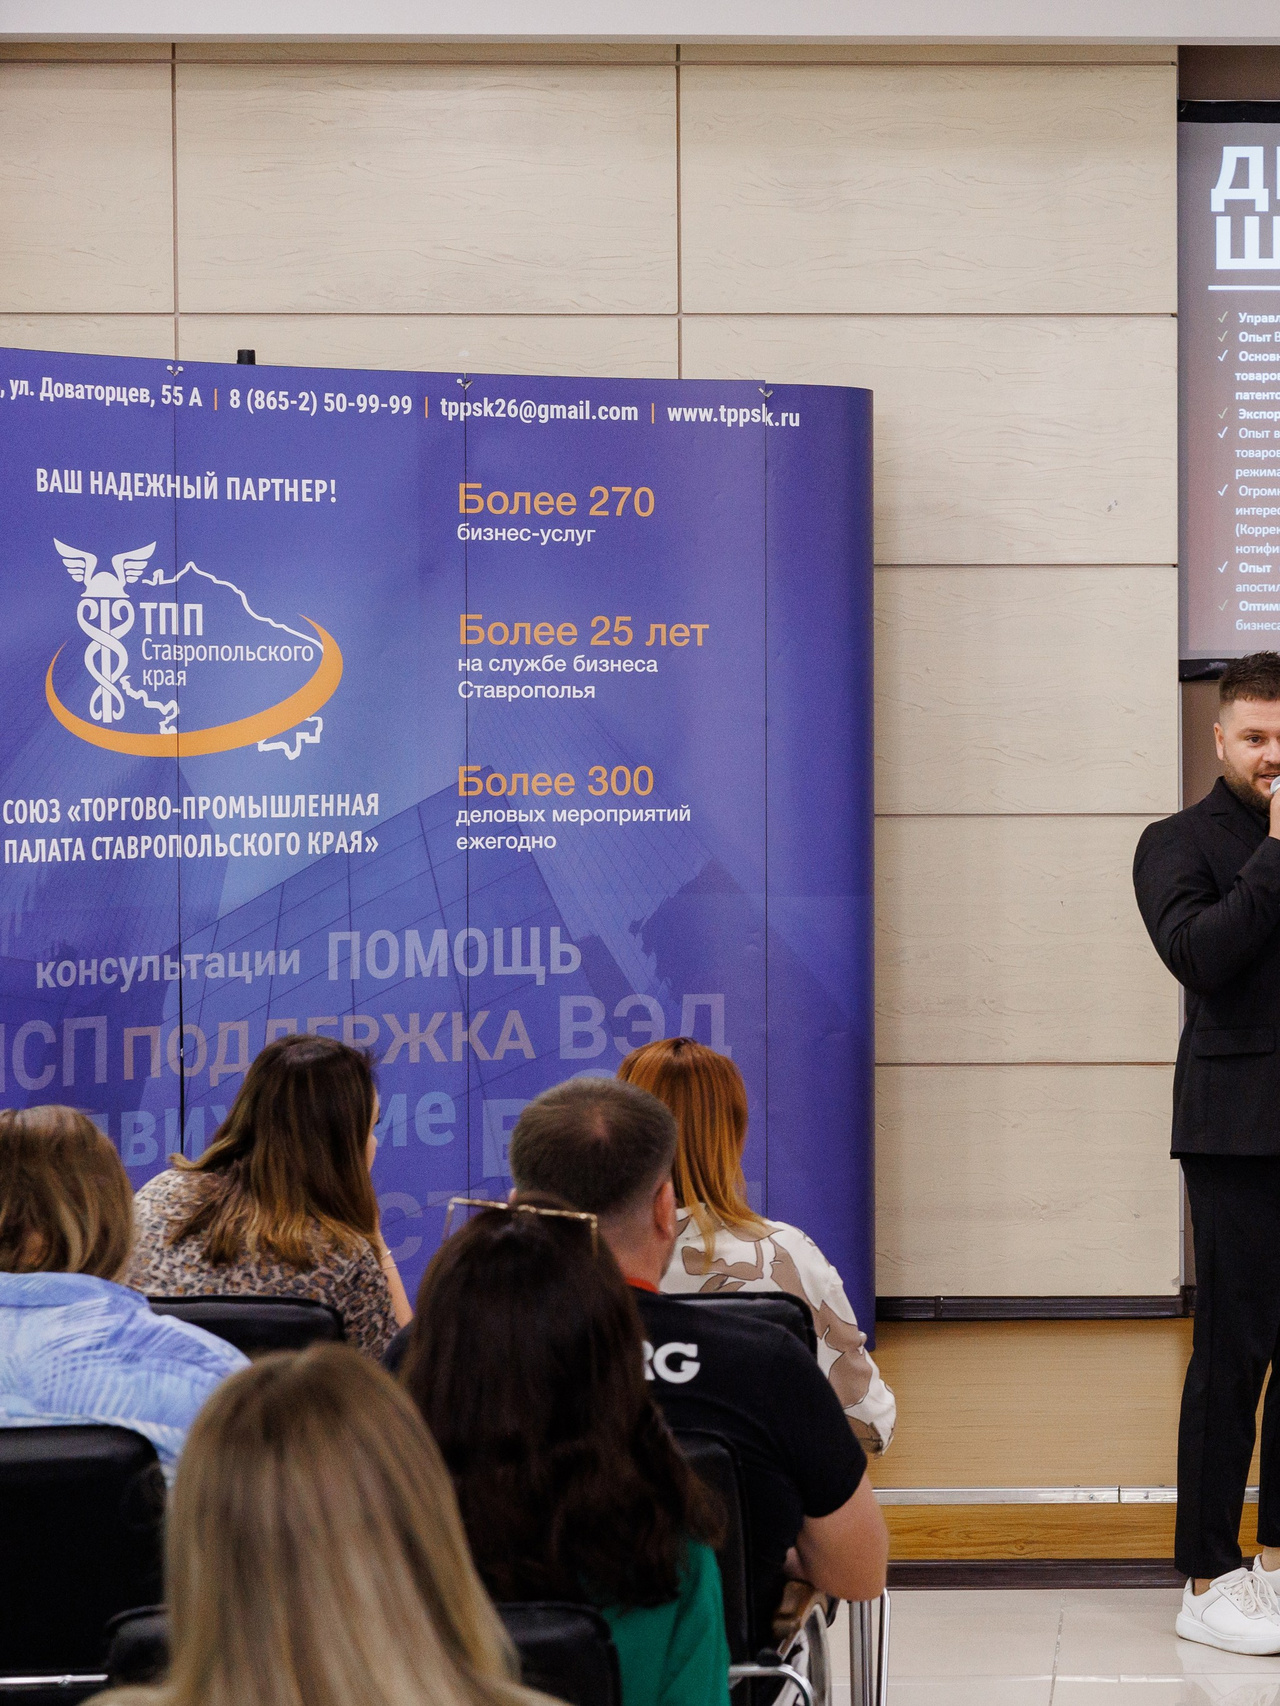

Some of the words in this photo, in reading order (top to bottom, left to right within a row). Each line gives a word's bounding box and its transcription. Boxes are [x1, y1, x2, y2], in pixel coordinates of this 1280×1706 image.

[1238, 331, 1272, 343] Опыт
[10, 377, 34, 401] ул.
[40, 377, 155, 407] Доваторцев,
[162, 385, 183, 405] 55
[189, 386, 202, 406] А
[229, 389, 240, 408] 8
[248, 389, 317, 416] (865-2)
[324, 393, 411, 414] 50-99-99
[440, 397, 638, 423] tppsk26@gmail.com
[667, 403, 800, 428] www.tppsk.ru
[36, 469, 82, 494] ВАШ
[90, 471, 218, 501] НАДЕЖНЫЙ
[227, 478, 337, 503] ПАРТНЕР!
[458, 483, 576, 515] Более
[589, 486, 655, 517] 270
[457, 523, 596, 546] бизнес-услуг
[140, 603, 203, 635] ТПП
[459, 614, 577, 646] Более
[590, 616, 633, 646] 25
[645, 623, 709, 647] лет
[142, 638, 314, 665] Ставропольского
[458, 656, 482, 672] на
[488, 655, 566, 675] службе
[573, 655, 658, 673] бизнеса
[142, 668, 186, 691] края
[458, 681, 595, 701] Ставрополья
[458, 765, 575, 797] Более
[588, 765, 654, 796] 300
[3, 799, 61, 824] СОЮЗ
[67, 793, 379, 822] «ТОРГОВО-ПРОМЫШЛЕННАЯ
[456, 808, 545, 826] деловых
[553, 805, 691, 825] мероприятий
[4, 838, 85, 863] ПАЛАТА
[92, 832, 300, 860] СТАВРОПОЛЬСКОГО
[308, 831, 379, 854] КРАЯ»
[456, 834, 556, 852] ежегодно
[36, 950, 298, 992] консультации
[328, 926, 582, 985] ПОМОЩЬ
[0, 1016, 107, 1093] СП
[559, 993, 732, 1060] ВЭД
